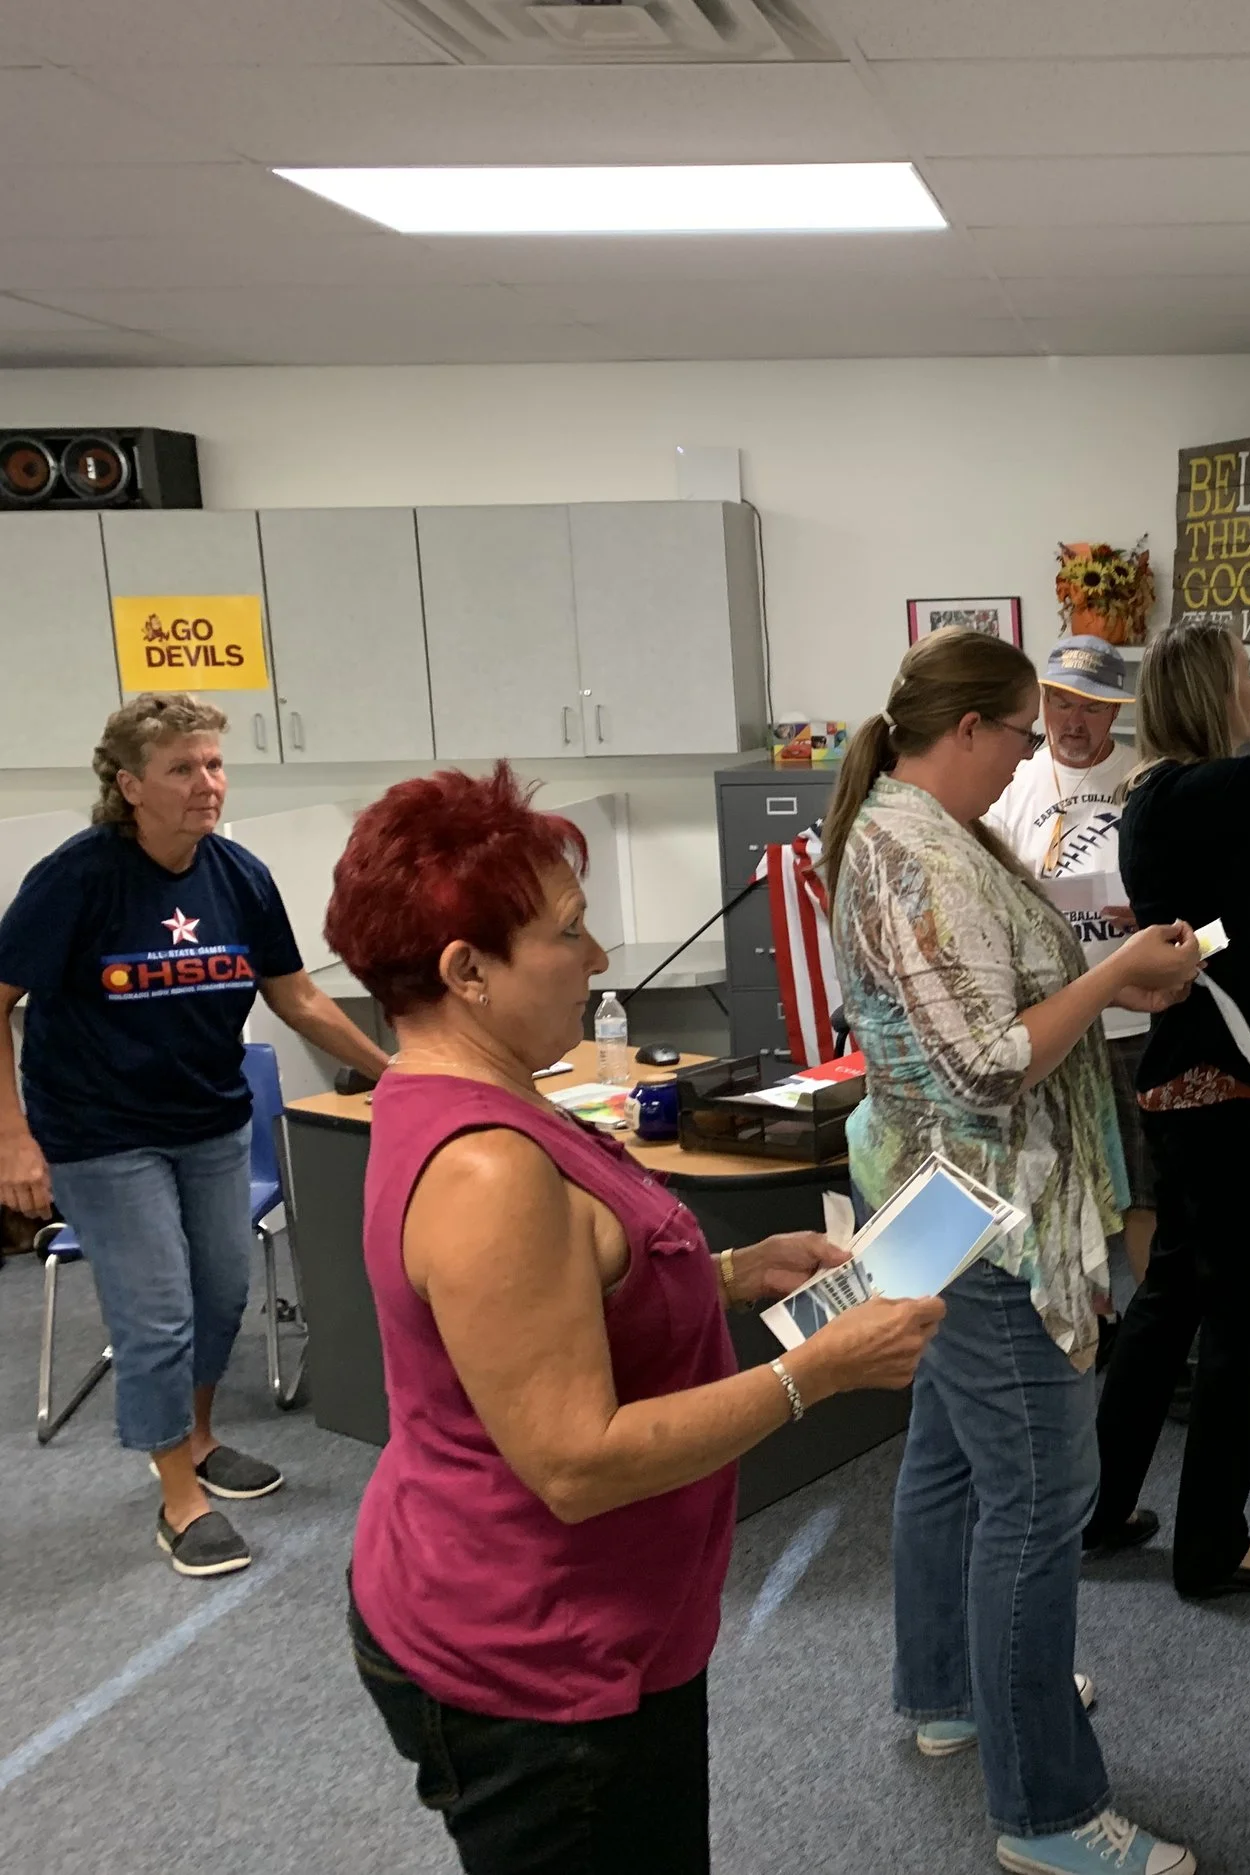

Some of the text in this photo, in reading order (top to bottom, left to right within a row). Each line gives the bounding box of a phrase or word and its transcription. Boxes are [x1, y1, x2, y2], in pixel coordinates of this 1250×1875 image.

[171, 618, 214, 642] GO
[145, 644, 245, 668] DEVILS
[1081, 794, 1115, 805] COLLI
[101, 954, 255, 993] CHSCA
